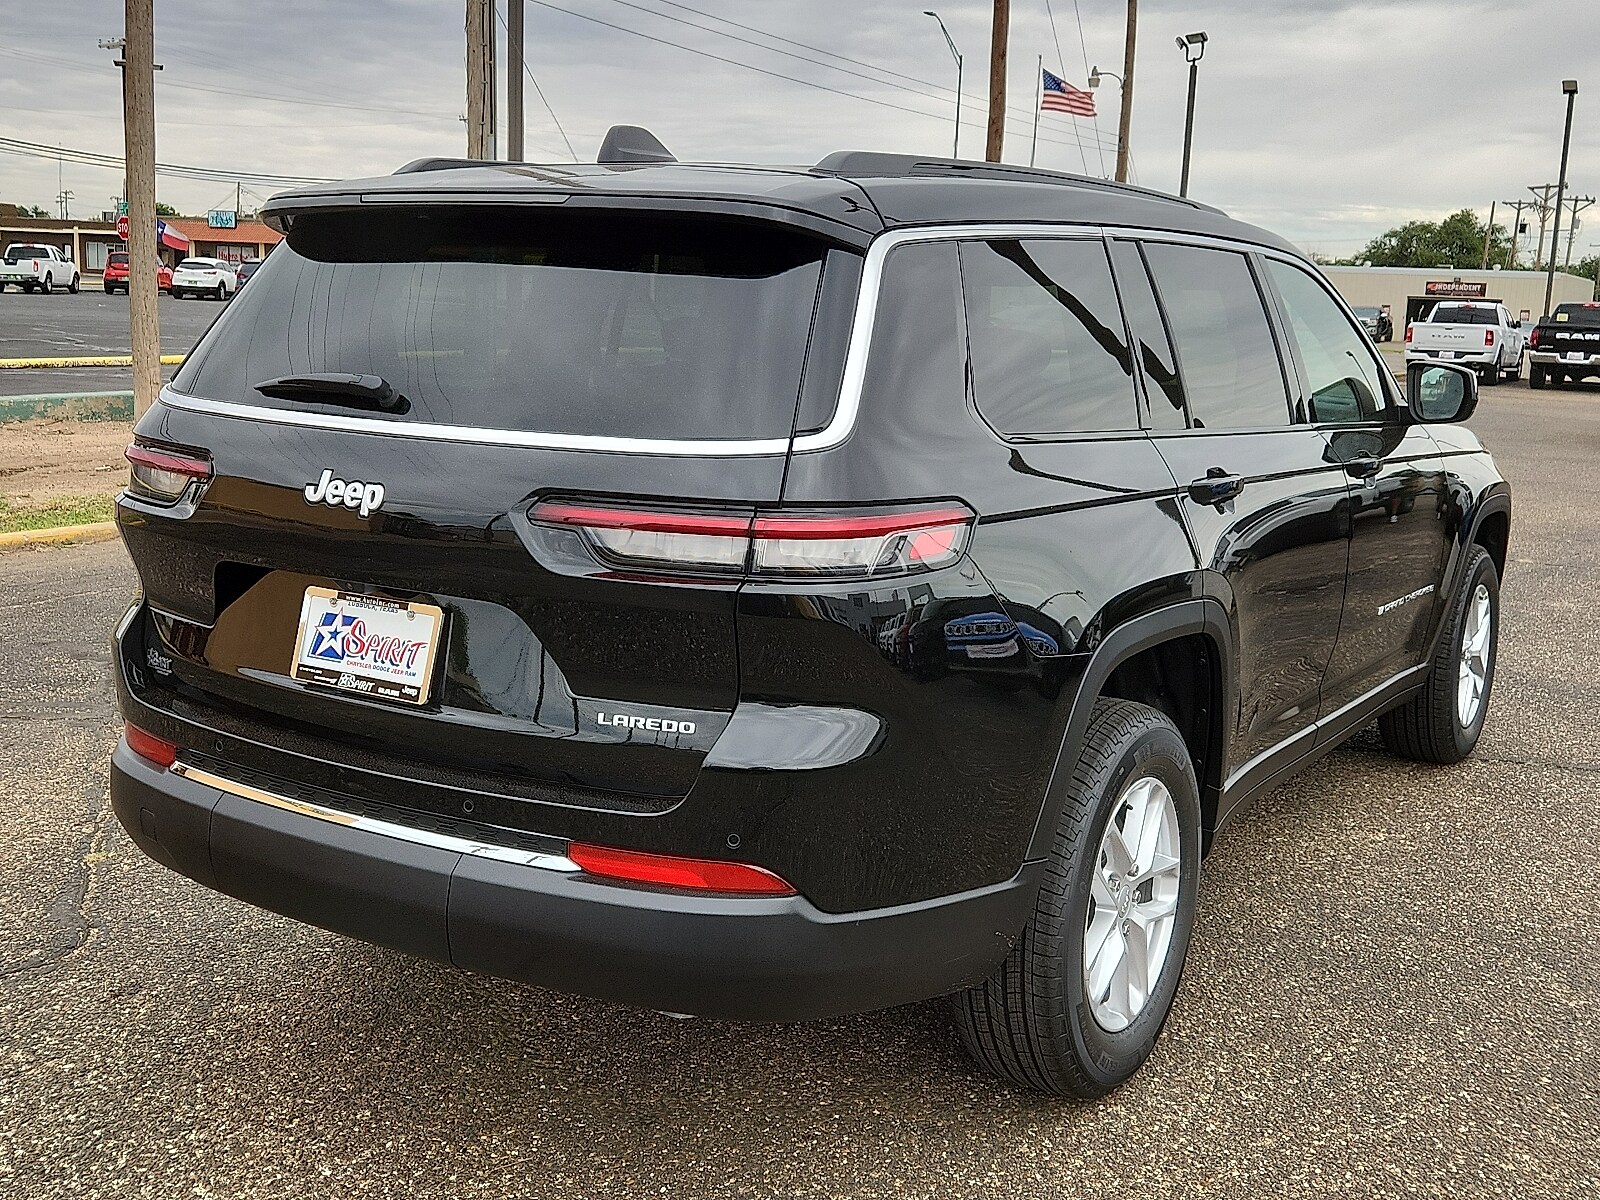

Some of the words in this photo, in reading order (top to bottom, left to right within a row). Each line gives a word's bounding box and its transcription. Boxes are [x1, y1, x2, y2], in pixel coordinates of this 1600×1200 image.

[118, 222, 128, 233] STO
[1555, 332, 1600, 341] RAM
[304, 468, 385, 518] Jeep
[345, 619, 429, 667] SPIRIT
[346, 660, 372, 670] CHRYSLER
[372, 664, 391, 673] DODGE
[401, 685, 418, 697] Jeep
[597, 712, 696, 734] LAREDO
